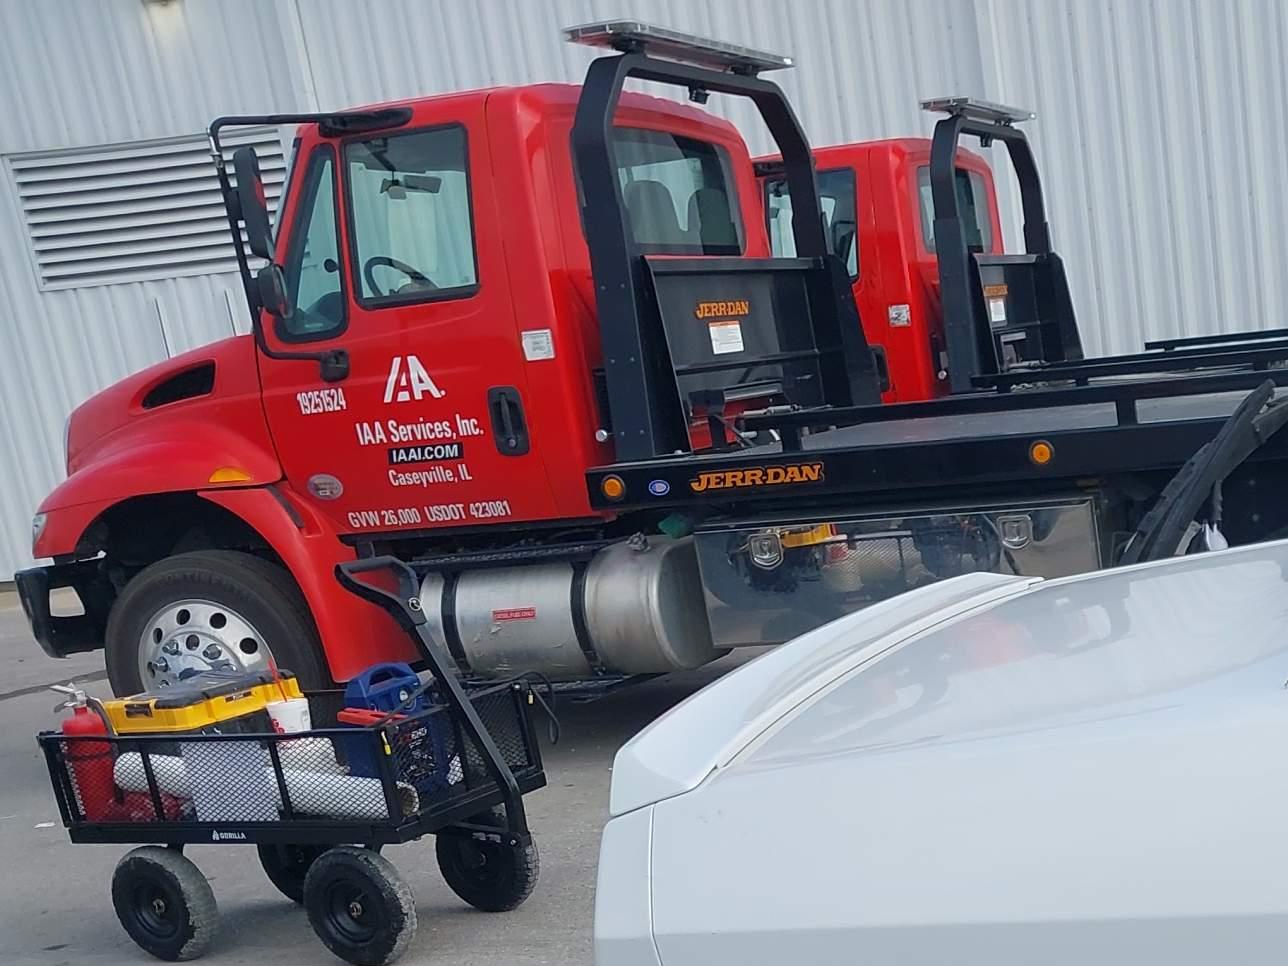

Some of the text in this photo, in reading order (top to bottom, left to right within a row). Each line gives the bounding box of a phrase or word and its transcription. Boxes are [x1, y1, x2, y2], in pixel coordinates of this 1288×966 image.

[296, 387, 347, 415] 19251524
[355, 413, 484, 446] IAA Services, Inc.
[392, 444, 459, 463] IAAI.COM
[388, 463, 473, 488] Caseyville, IL
[690, 464, 821, 491] JERR-DAN
[347, 500, 512, 528] GVW 26,000 USDOT 423081
